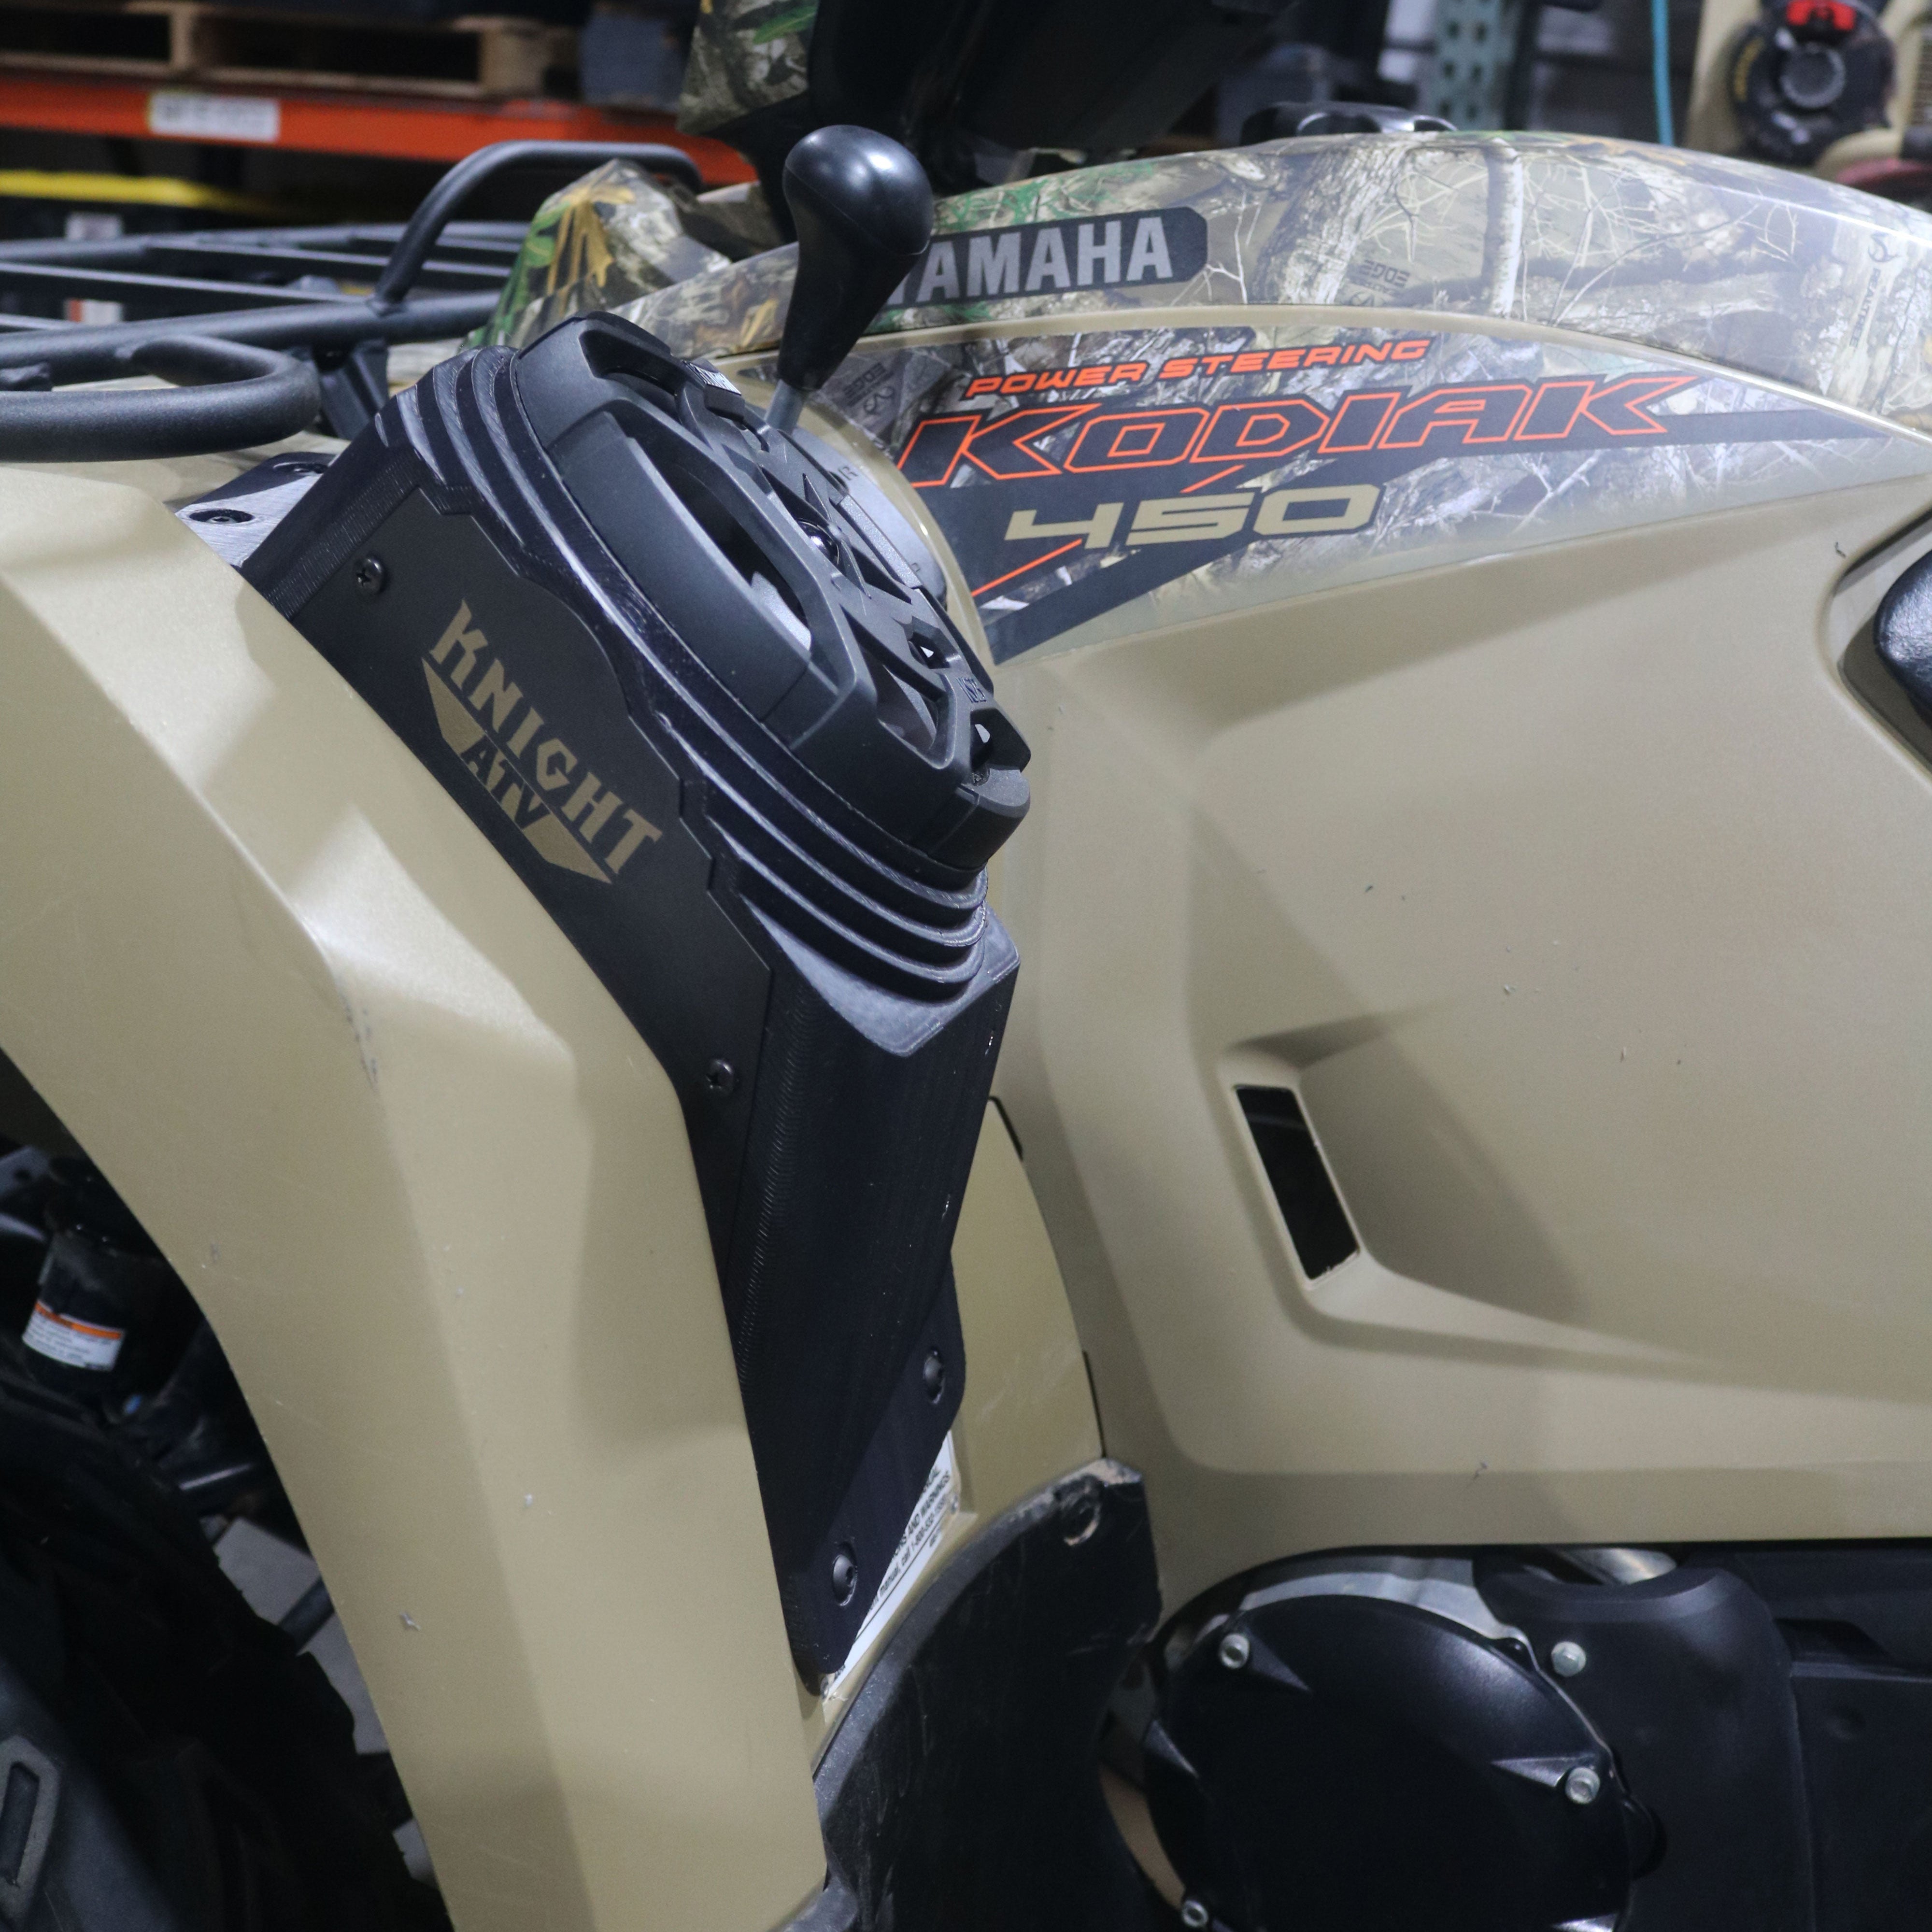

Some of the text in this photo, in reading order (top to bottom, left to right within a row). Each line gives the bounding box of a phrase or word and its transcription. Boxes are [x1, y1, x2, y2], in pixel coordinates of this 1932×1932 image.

[966, 340, 1431, 398] POWER STEERING
[896, 375, 1699, 487] KODIAK
[1004, 484, 1382, 549] 450
[429, 597, 663, 874] KNIGHT
[459, 735, 552, 831] ATV
